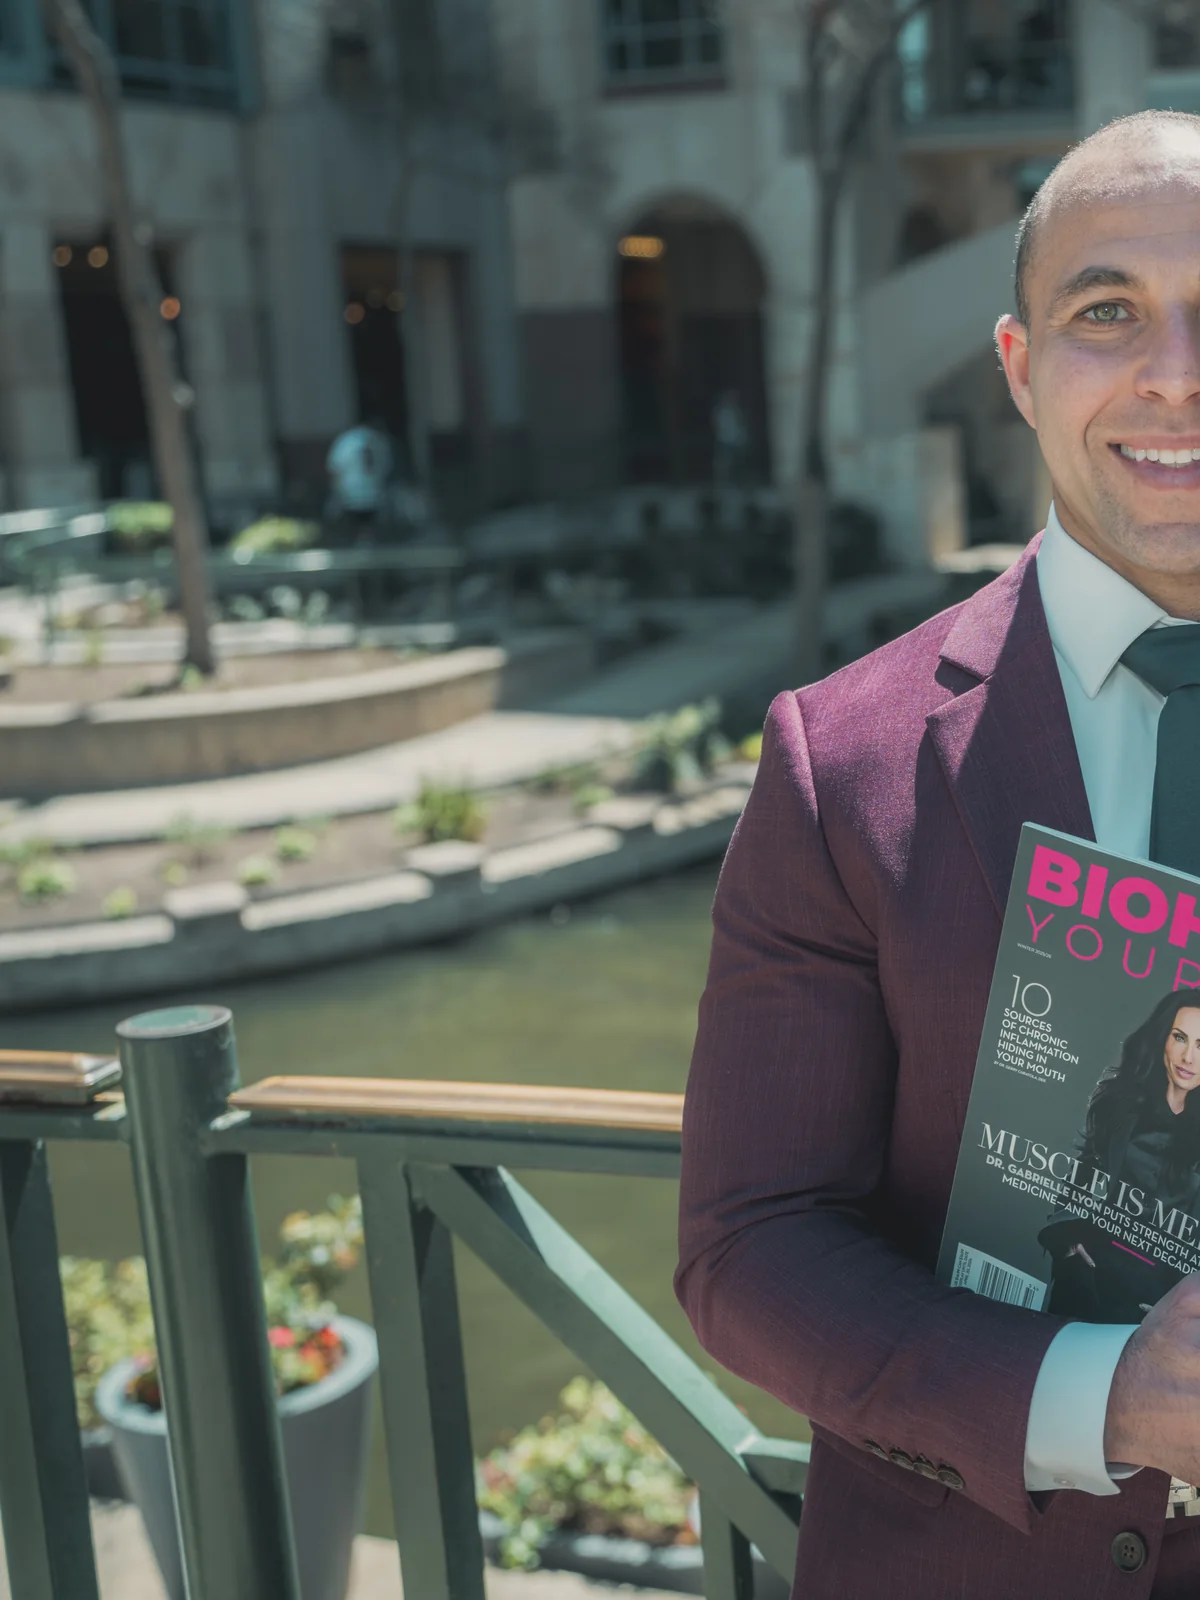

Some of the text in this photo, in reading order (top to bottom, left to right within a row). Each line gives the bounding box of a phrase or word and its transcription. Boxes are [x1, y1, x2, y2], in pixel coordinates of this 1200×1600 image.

[1012, 974, 1052, 1017] 10
[1002, 1018, 1068, 1050] OF CHRONIC
[1003, 1007, 1052, 1033] SOURCES
[998, 1039, 1048, 1065] HIDING IN
[1000, 1028, 1080, 1065] INFLAMMATION
[996, 1049, 1066, 1083] YOUR MOUTH
[977, 1122, 1111, 1200] MUSCLE
[1113, 1180, 1146, 1217] IS
[986, 1154, 1005, 1169] DR.
[1008, 1162, 1070, 1198] GABRIELLE
[1072, 1190, 1102, 1214] LYON
[1103, 1206, 1131, 1229] PUTS
[1132, 1221, 1190, 1260] STRENGTH
[1092, 1214, 1122, 1238] YOUR
[1122, 1231, 1152, 1254] NEXT
